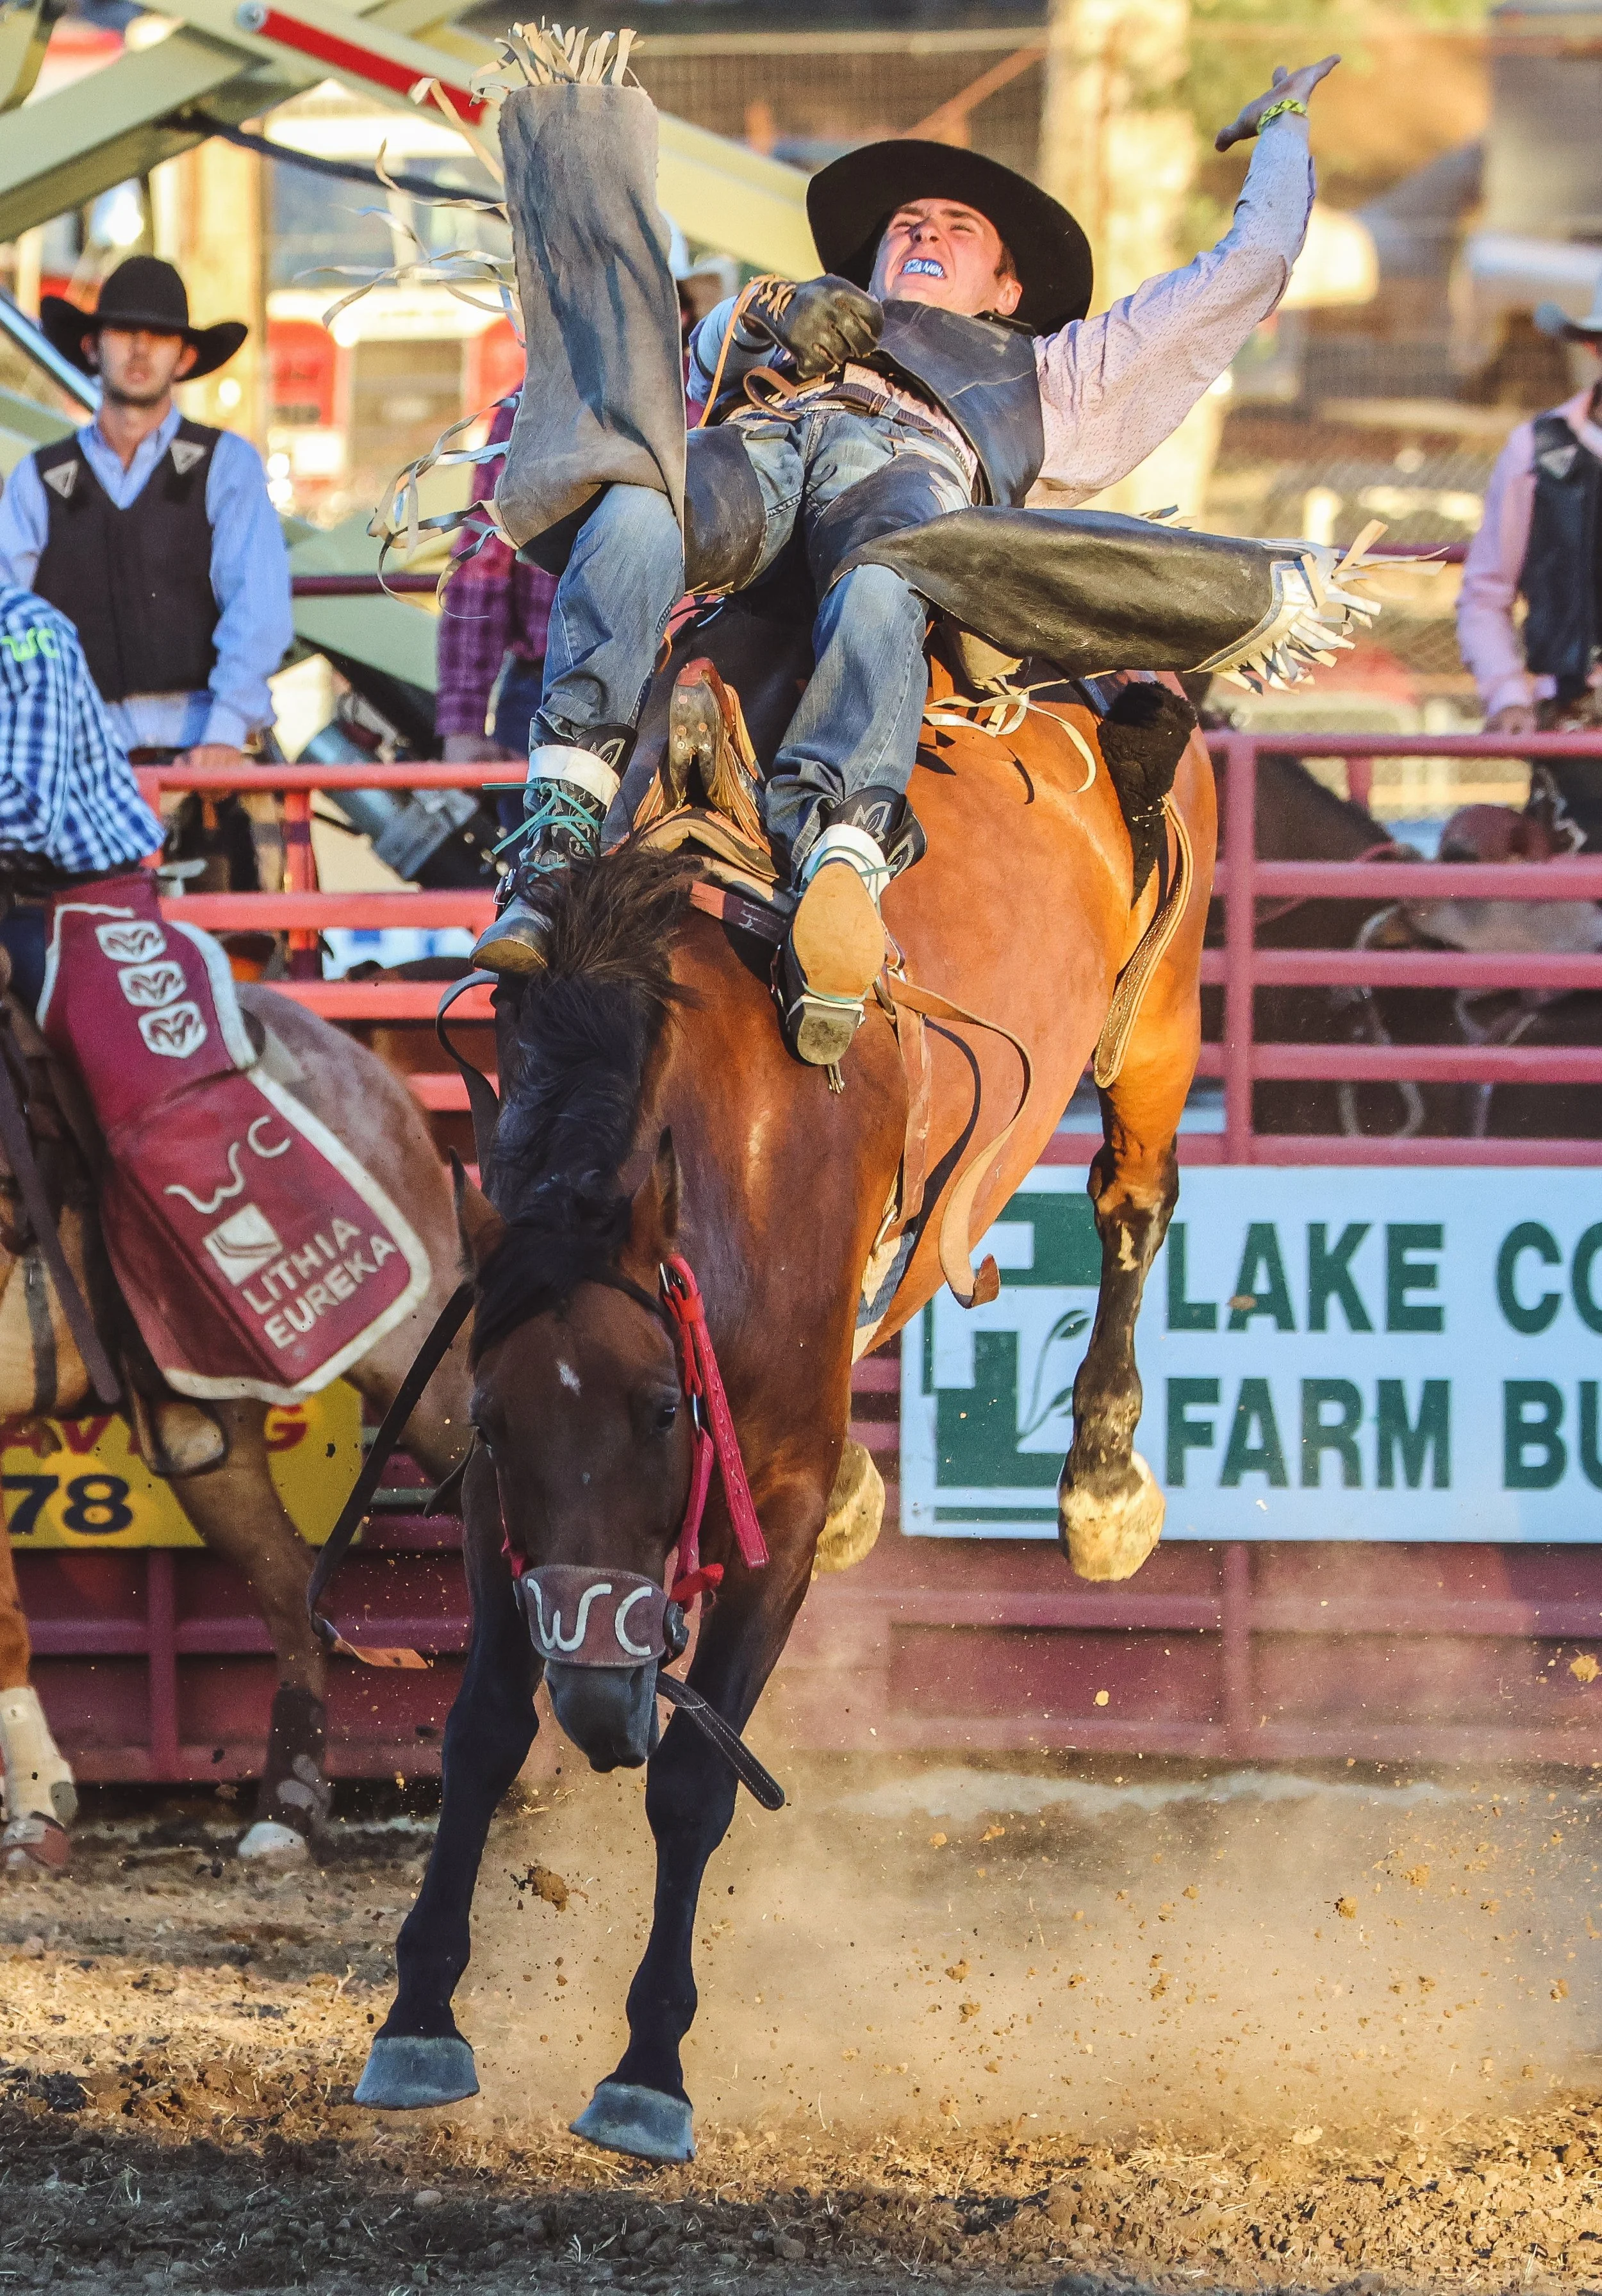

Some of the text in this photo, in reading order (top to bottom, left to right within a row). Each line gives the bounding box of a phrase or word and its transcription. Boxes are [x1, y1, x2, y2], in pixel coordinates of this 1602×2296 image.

[242, 1218, 361, 1315] LITHIA
[264, 1235, 398, 1349] EUREKA
[1165, 1221, 1446, 1333] LAKE
[1164, 1377, 1451, 1489] FARM
[3, 1474, 133, 1535] 78
[527, 1578, 653, 1656] WC
